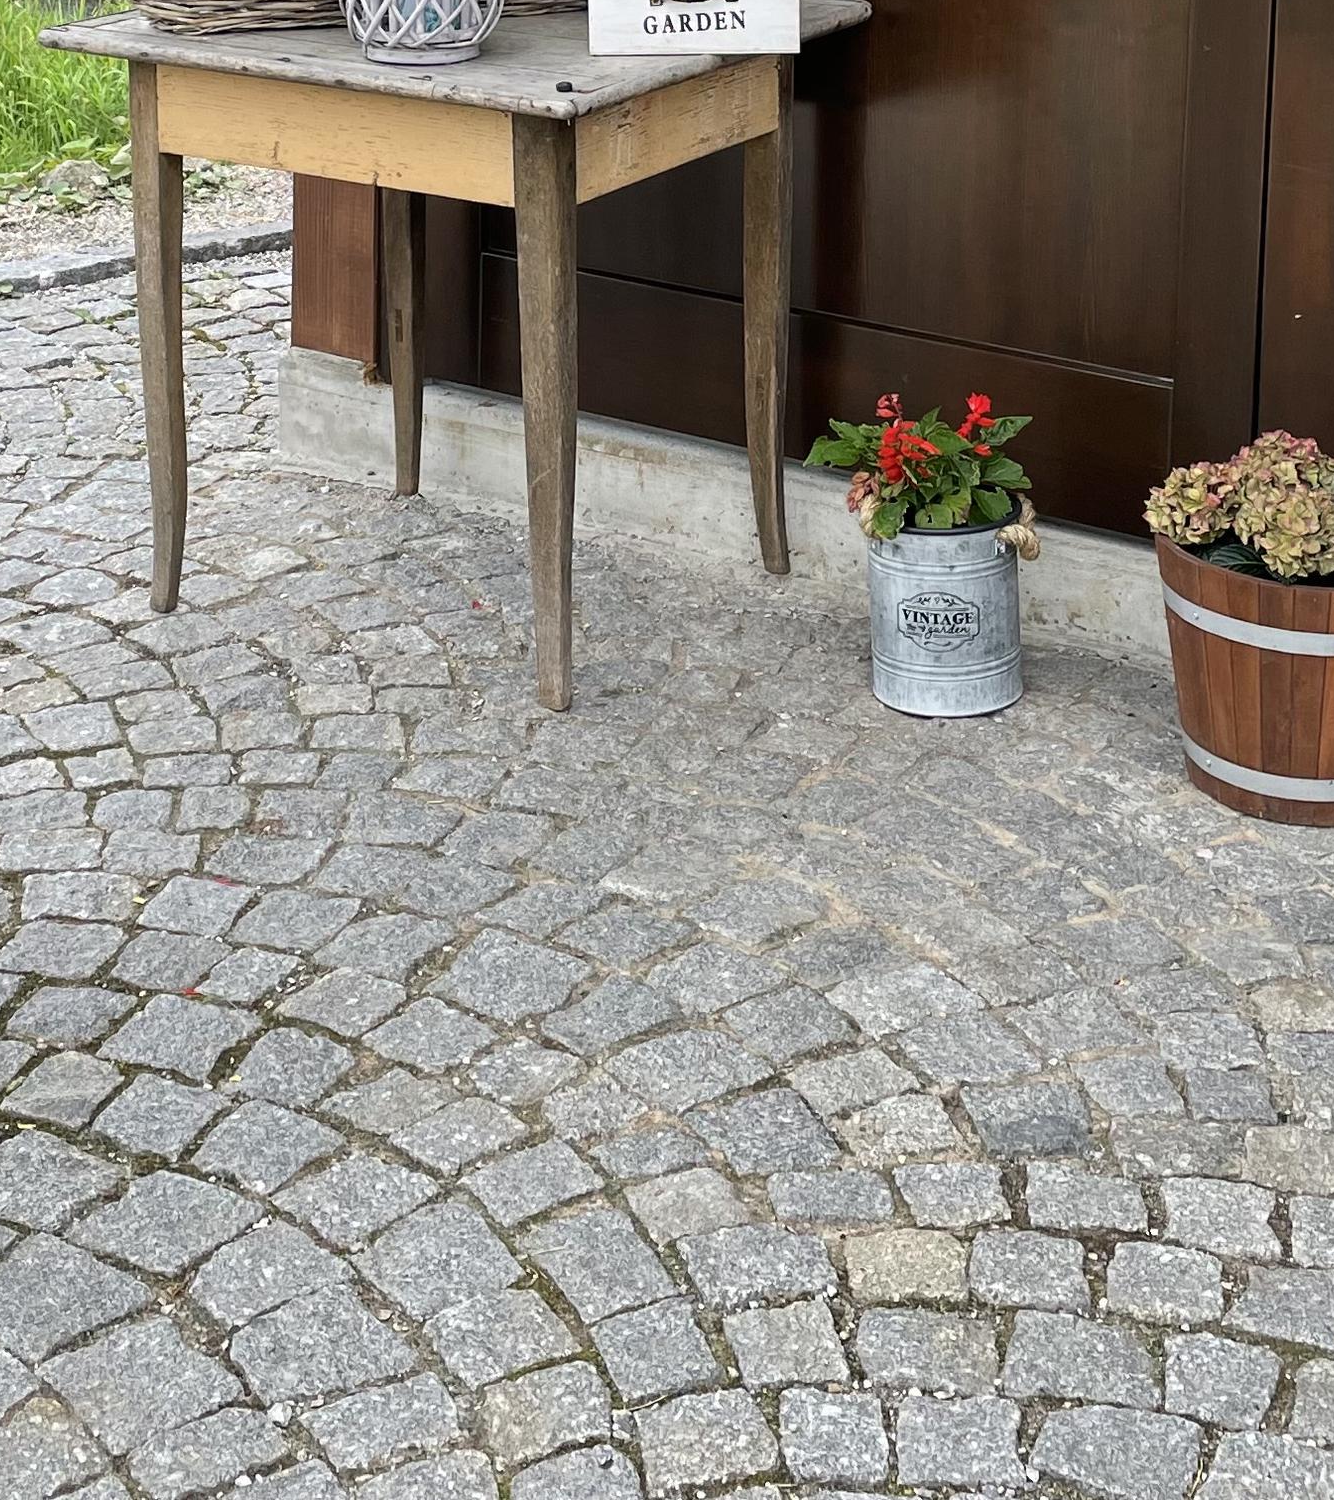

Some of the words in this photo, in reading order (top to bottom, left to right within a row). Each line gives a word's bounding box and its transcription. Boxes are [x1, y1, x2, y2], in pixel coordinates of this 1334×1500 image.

[643, 10, 747, 35] GARDEN
[902, 608, 975, 626] VINTAGE
[924, 624, 972, 640] garden
